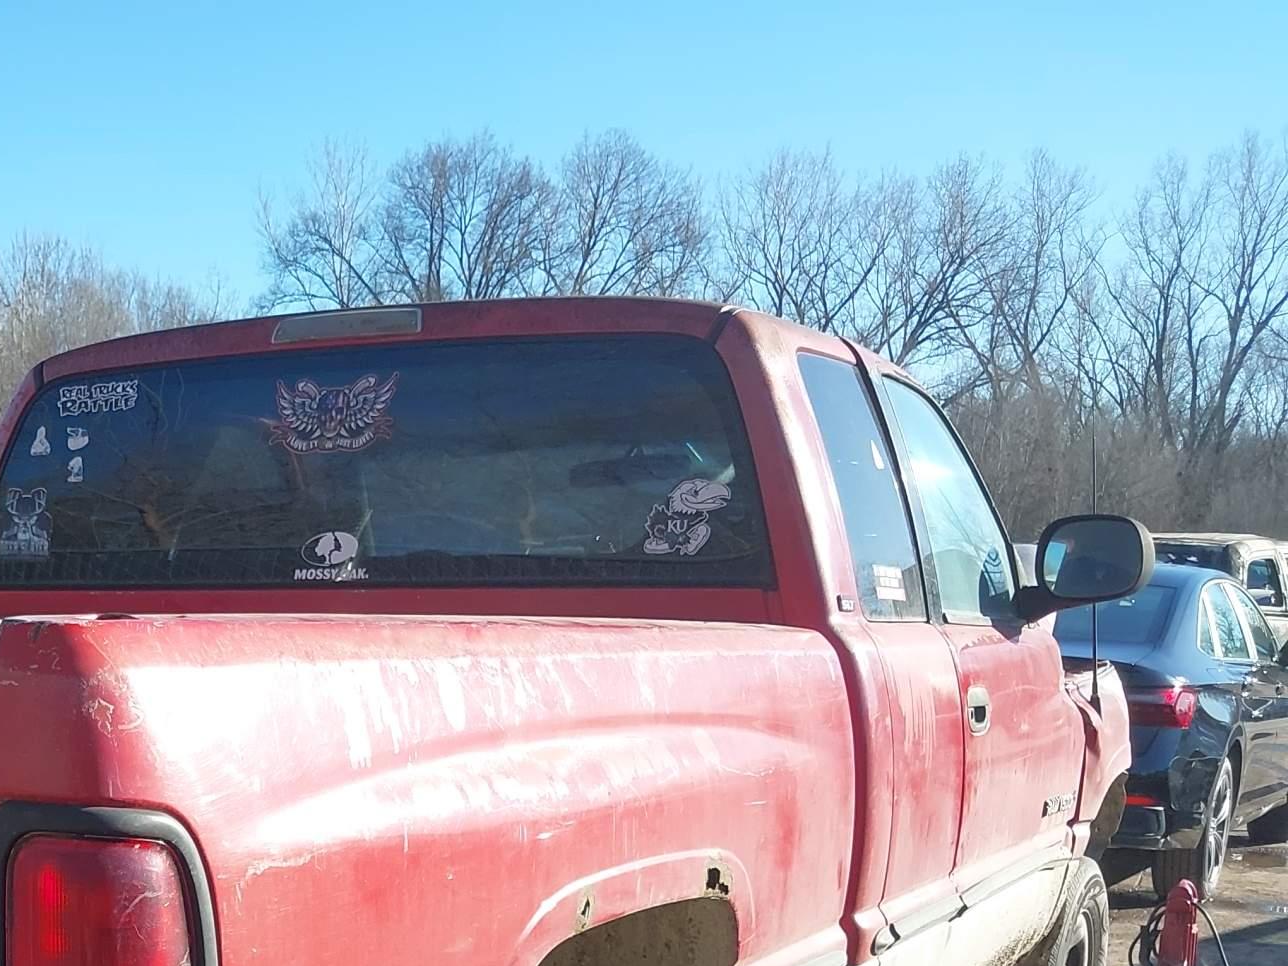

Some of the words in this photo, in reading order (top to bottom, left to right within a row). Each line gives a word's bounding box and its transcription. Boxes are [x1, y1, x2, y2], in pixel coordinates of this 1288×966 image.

[60, 385, 89, 400] REAL
[92, 379, 138, 398] TRUCKS
[58, 394, 138, 416] RATTLE
[667, 519, 688, 535] KU
[294, 567, 338, 580] MOSSY
